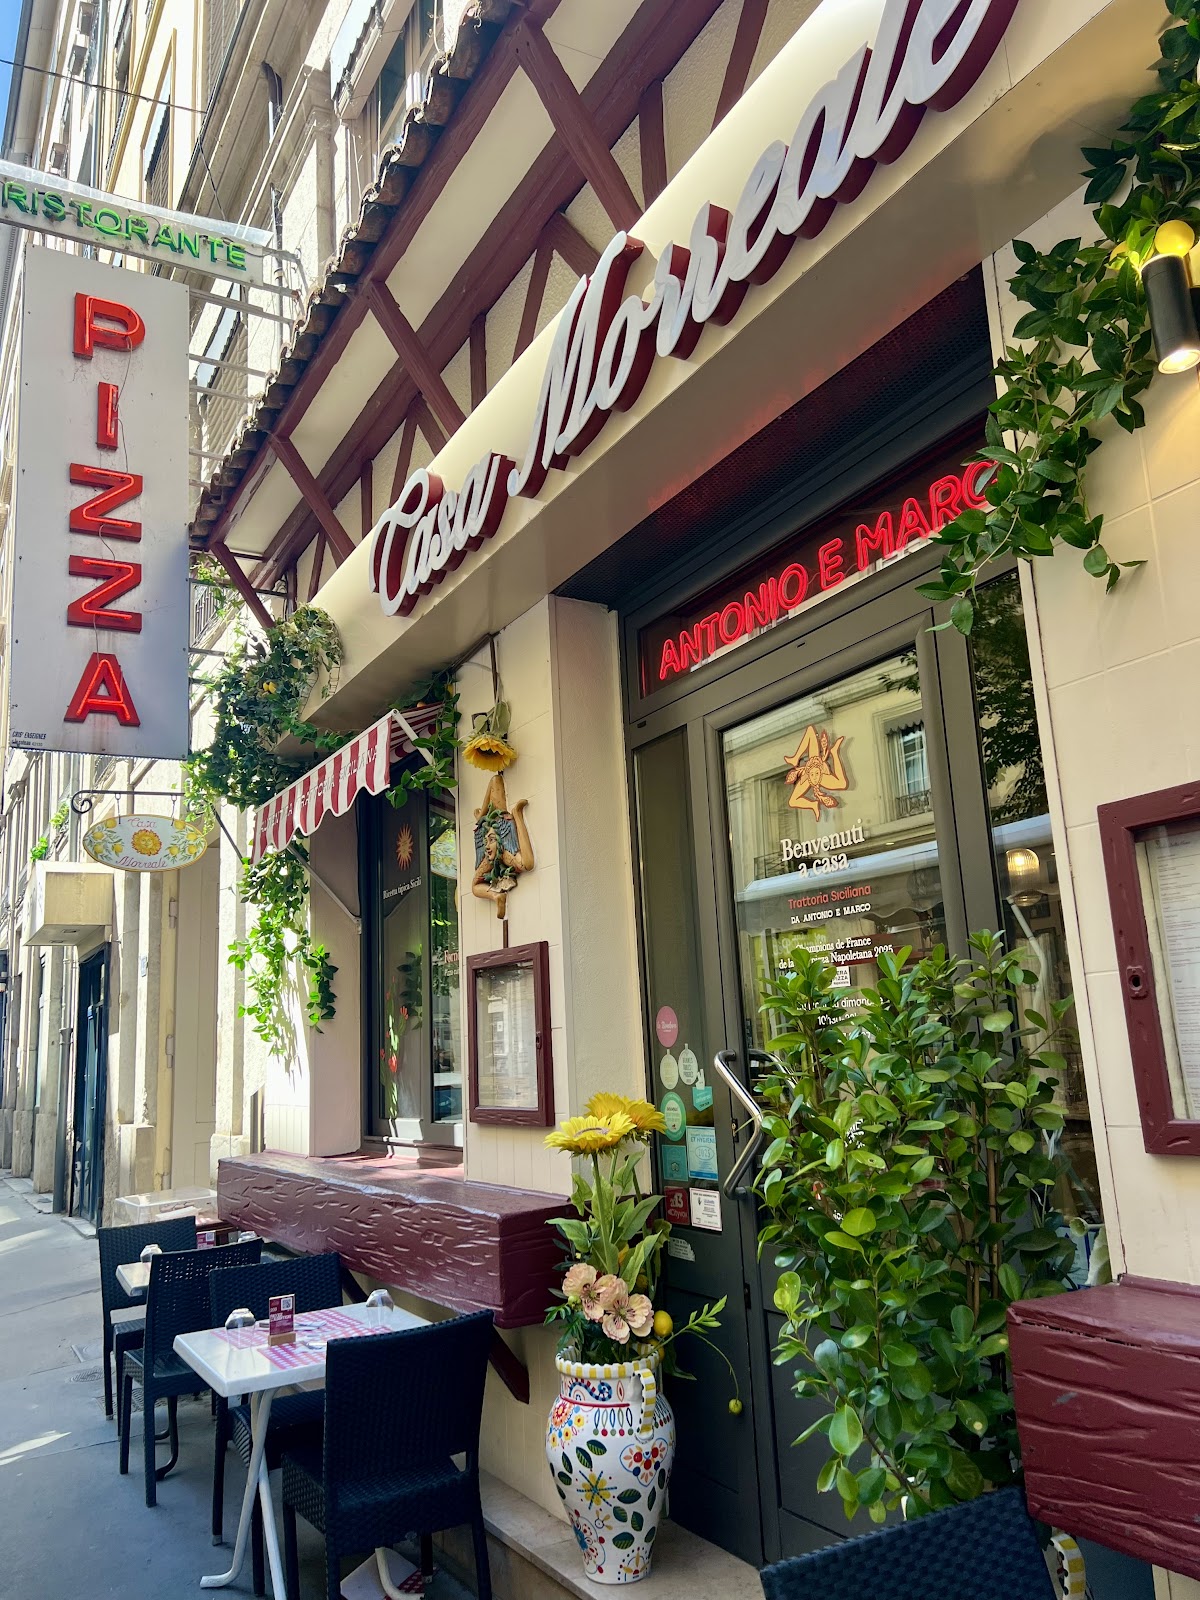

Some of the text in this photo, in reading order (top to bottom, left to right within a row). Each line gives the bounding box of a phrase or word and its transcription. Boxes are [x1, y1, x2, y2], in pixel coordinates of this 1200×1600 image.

[1, 181, 247, 271] RISTORANTE
[369, 0, 992, 616] Casa Morreale
[64, 292, 146, 727] PIZZA
[658, 460, 999, 681] ANTONIO E MARC
[128, 818, 157, 828] Casa
[780, 818, 865, 861] Benvenuti
[116, 856, 168, 869] Morreale
[798, 852, 849, 878] a casa
[788, 885, 871, 909] Trattoria Siciliana
[791, 902, 871, 924] DA ANTONIO E MARCO
[836, 939, 845, 949] de
[846, 937, 871, 948] France
[779, 958, 788, 970] de
[788, 957, 795, 968] la
[830, 949, 873, 964] Napoletana
[874, 945, 894, 958] 2025
